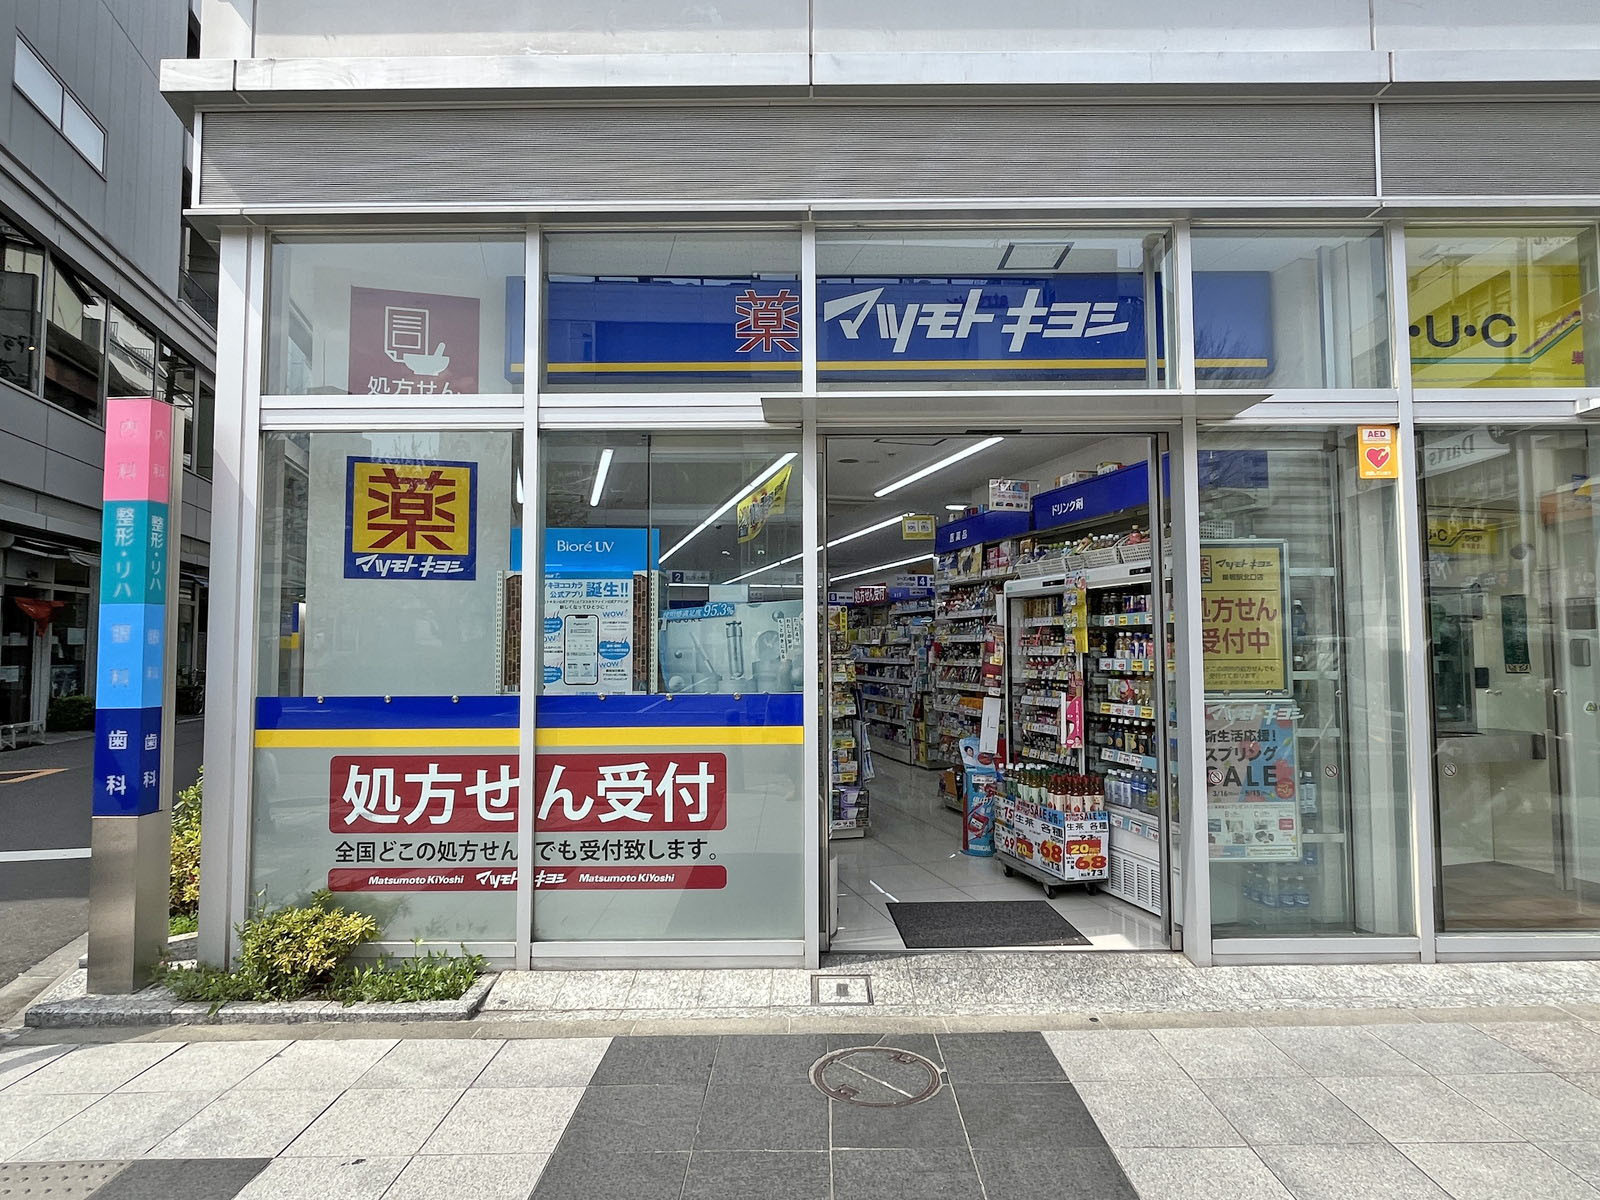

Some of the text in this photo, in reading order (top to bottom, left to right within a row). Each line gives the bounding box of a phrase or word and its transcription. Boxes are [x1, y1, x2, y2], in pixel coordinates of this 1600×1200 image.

[734, 287, 1129, 354] 薬 マツモトキヨシ
[1367, 430, 1386, 438] AED
[117, 419, 139, 481] 内科
[367, 468, 457, 551] 薬
[1051, 497, 1084, 517] ドリンク剤
[557, 540, 615, 553] Bioré UV
[355, 554, 465, 578] マツモトキヨシ
[1215, 558, 1273, 571] マツモトキヨシ
[674, 573, 681, 582] 2
[919, 577, 927, 587] 4
[550, 591, 584, 599] 公式アプリ
[703, 603, 735, 617] 95.3%
[1203, 627, 1270, 655] 受付中
[143, 733, 158, 789] 歯科
[1206, 746, 1279, 762] スプリング
[106, 729, 129, 797] 歯科
[342, 761, 716, 826] 処方せん受付
[1030, 804, 1048, 821] SALE
[1079, 813, 1097, 821] SALE
[1015, 813, 1063, 839] 生茶 各種
[1066, 822, 1108, 831] 生茶 各種
[335, 838, 717, 863] 全国どこの処方せんでも受付致します。
[1040, 839, 1063, 863] 68
[1070, 843, 1089, 854] 20
[1075, 855, 1107, 870] 68
[368, 874, 465, 885] Matsumoto KiYoshi
[475, 869, 568, 889] マツモトキヨシ
[578, 872, 675, 883] Matsumoto KiYoshi
